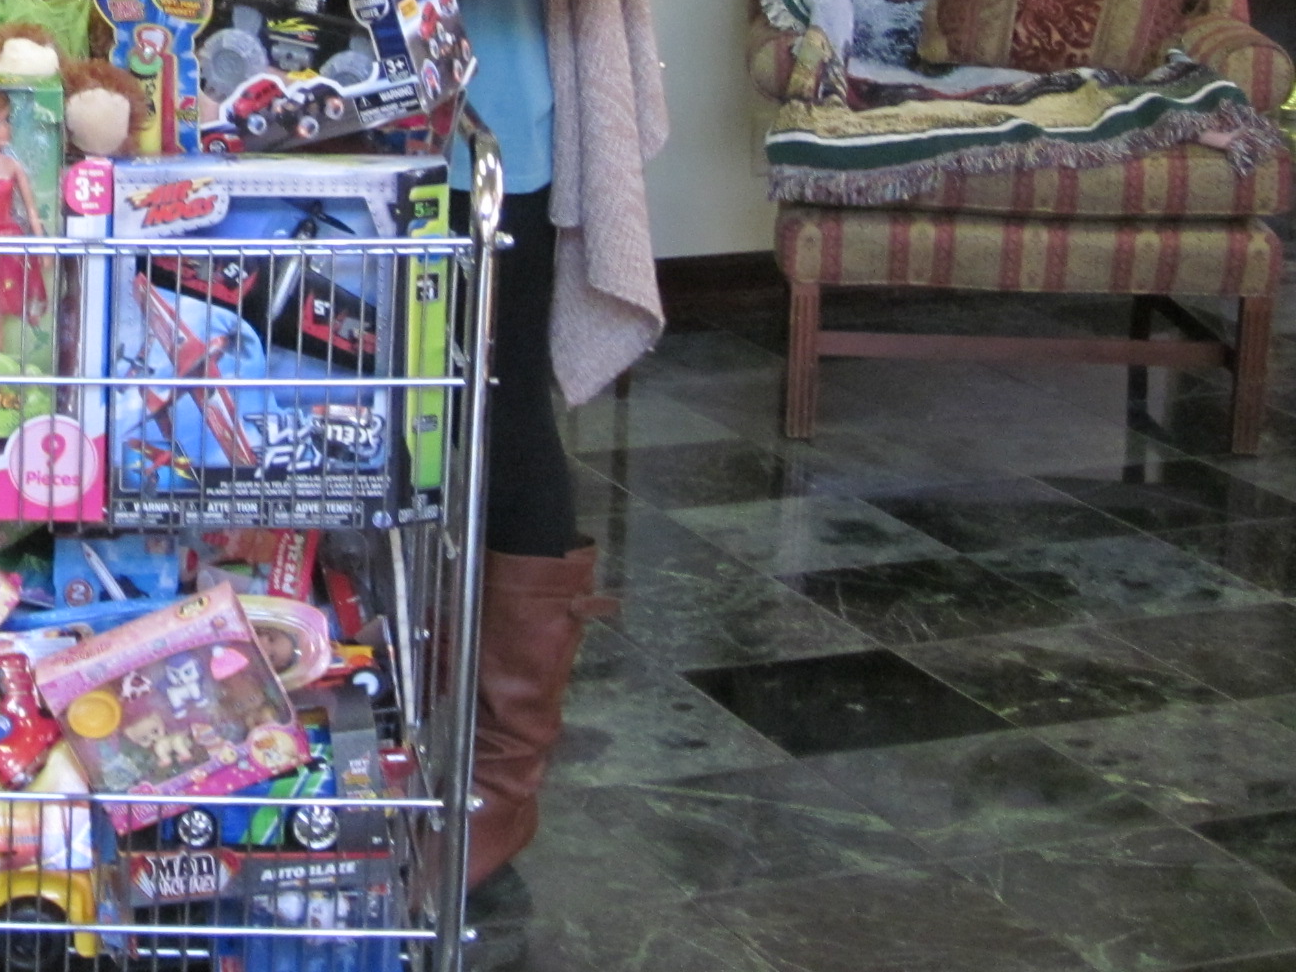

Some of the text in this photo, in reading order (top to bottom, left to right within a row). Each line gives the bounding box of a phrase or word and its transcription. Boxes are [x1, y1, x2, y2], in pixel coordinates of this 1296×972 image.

[386, 59, 406, 76] 3+
[74, 176, 105, 202] 3+
[40, 432, 67, 468] 9
[25, 469, 80, 488] Pieces
[207, 503, 258, 514] ATTETION
